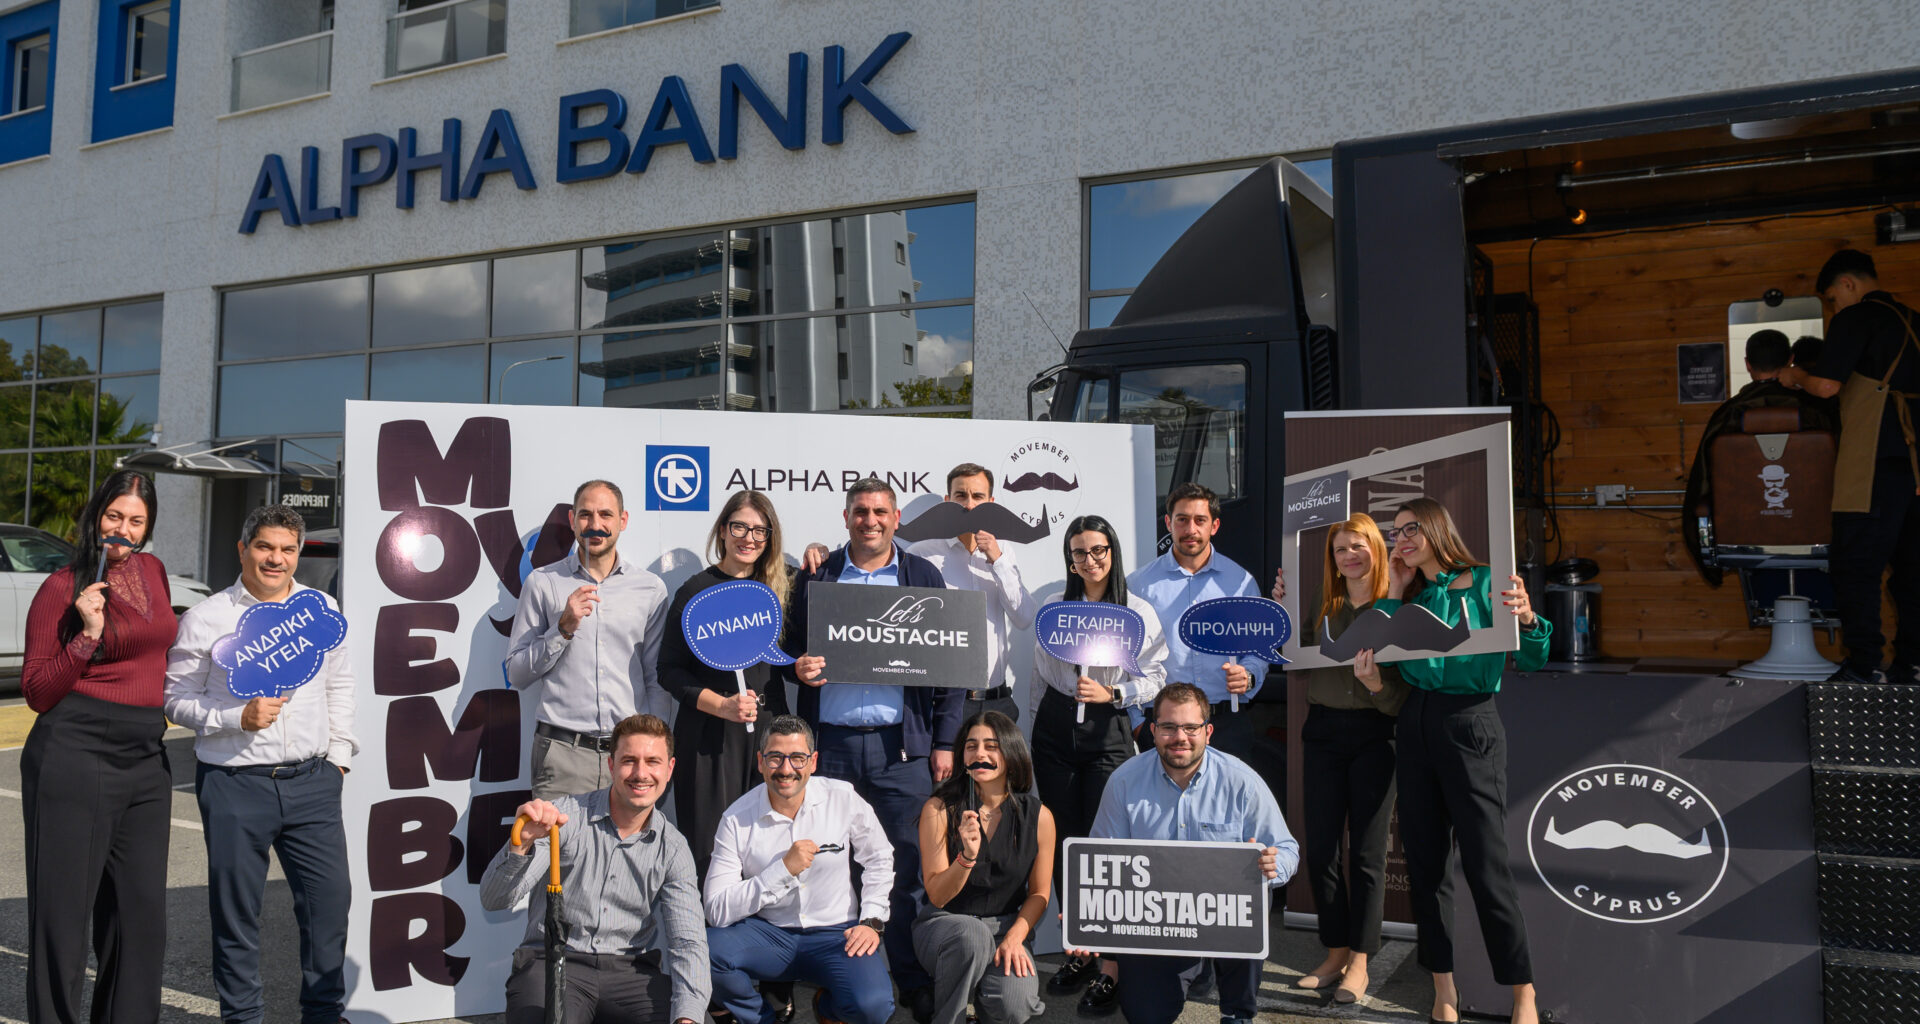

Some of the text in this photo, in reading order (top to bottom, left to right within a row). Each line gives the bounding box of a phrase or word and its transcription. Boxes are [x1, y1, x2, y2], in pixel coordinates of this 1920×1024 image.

[238, 31, 917, 235] ALPHA BANK
[1010, 442, 1069, 463] MOVEMBER
[725, 468, 834, 492] ALPHA
[1287, 493, 1341, 514] MOUSTACHE
[1020, 511, 1065, 526] CYPUS
[696, 609, 772, 641] ΔΥΝΑΜΗ
[866, 595, 944, 628] Let's
[1057, 613, 1125, 633] ΕΓΚΑΙΡΗ
[235, 607, 315, 668] ΑΝΔΡΙΚΗ
[828, 624, 969, 648] MOUSTACHE
[1189, 621, 1274, 636] ΠΡΟΛΗΨΗ
[257, 635, 314, 674] ΥΓΕΙΑ
[872, 666, 904, 674] MOVEMBER
[1557, 772, 1697, 810] MOVEMBER
[1079, 853, 1151, 888] LET'S
[1079, 888, 1253, 928] MOUSTACHE
[1573, 884, 1682, 914] CYPRUS
[1112, 923, 1198, 939] MOVEMBER CYPRUS
